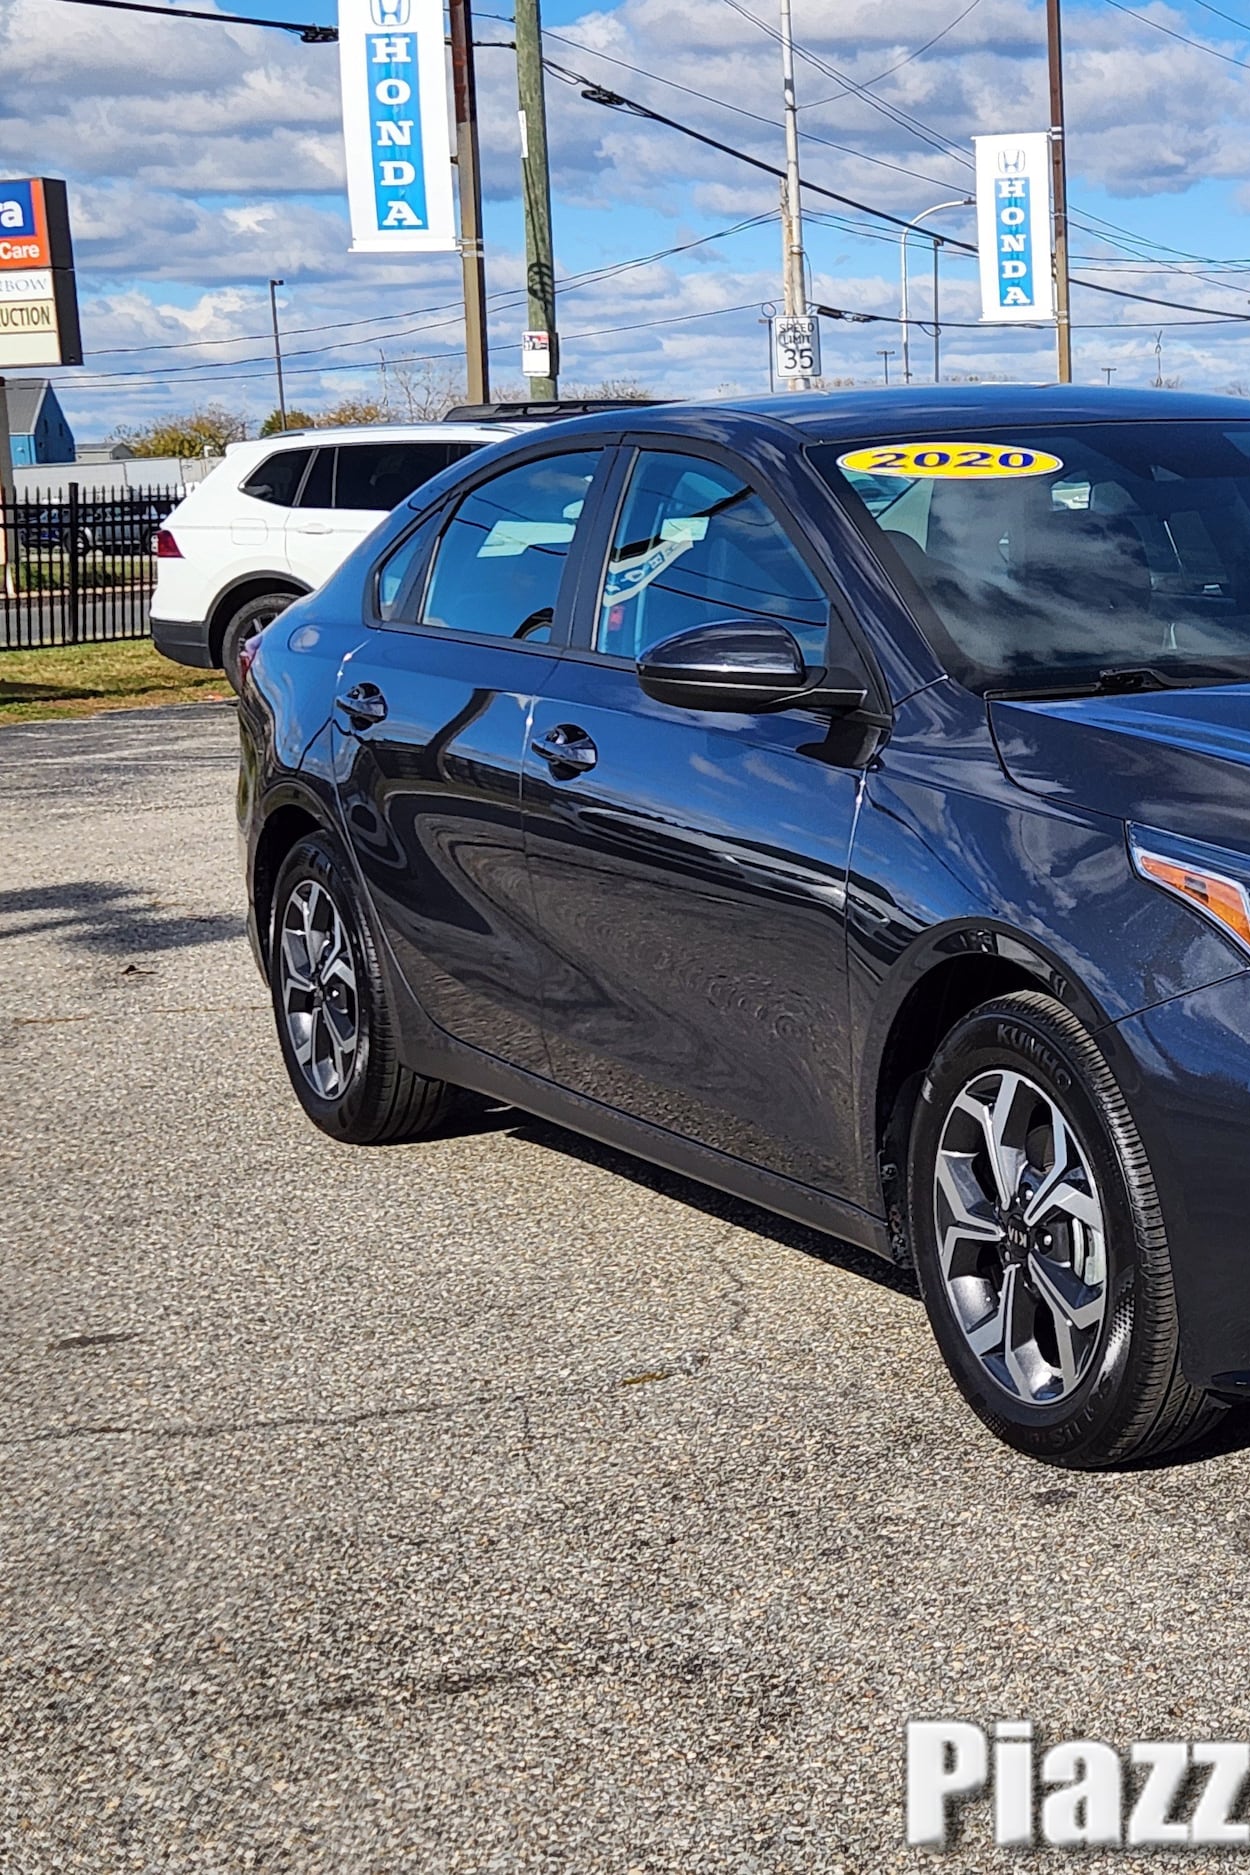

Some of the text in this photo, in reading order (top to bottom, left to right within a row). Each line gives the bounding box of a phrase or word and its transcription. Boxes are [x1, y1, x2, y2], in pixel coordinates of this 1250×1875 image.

[371, 37, 423, 226] HONDA
[0, 200, 24, 228] a
[0, 241, 40, 259] Care
[998, 179, 1031, 305] HONDA
[0, 306, 50, 327] UCTION
[779, 322, 815, 334] SPEED
[783, 334, 811, 345] LIMIT
[784, 348, 814, 369] 35
[868, 451, 1035, 469] 2020
